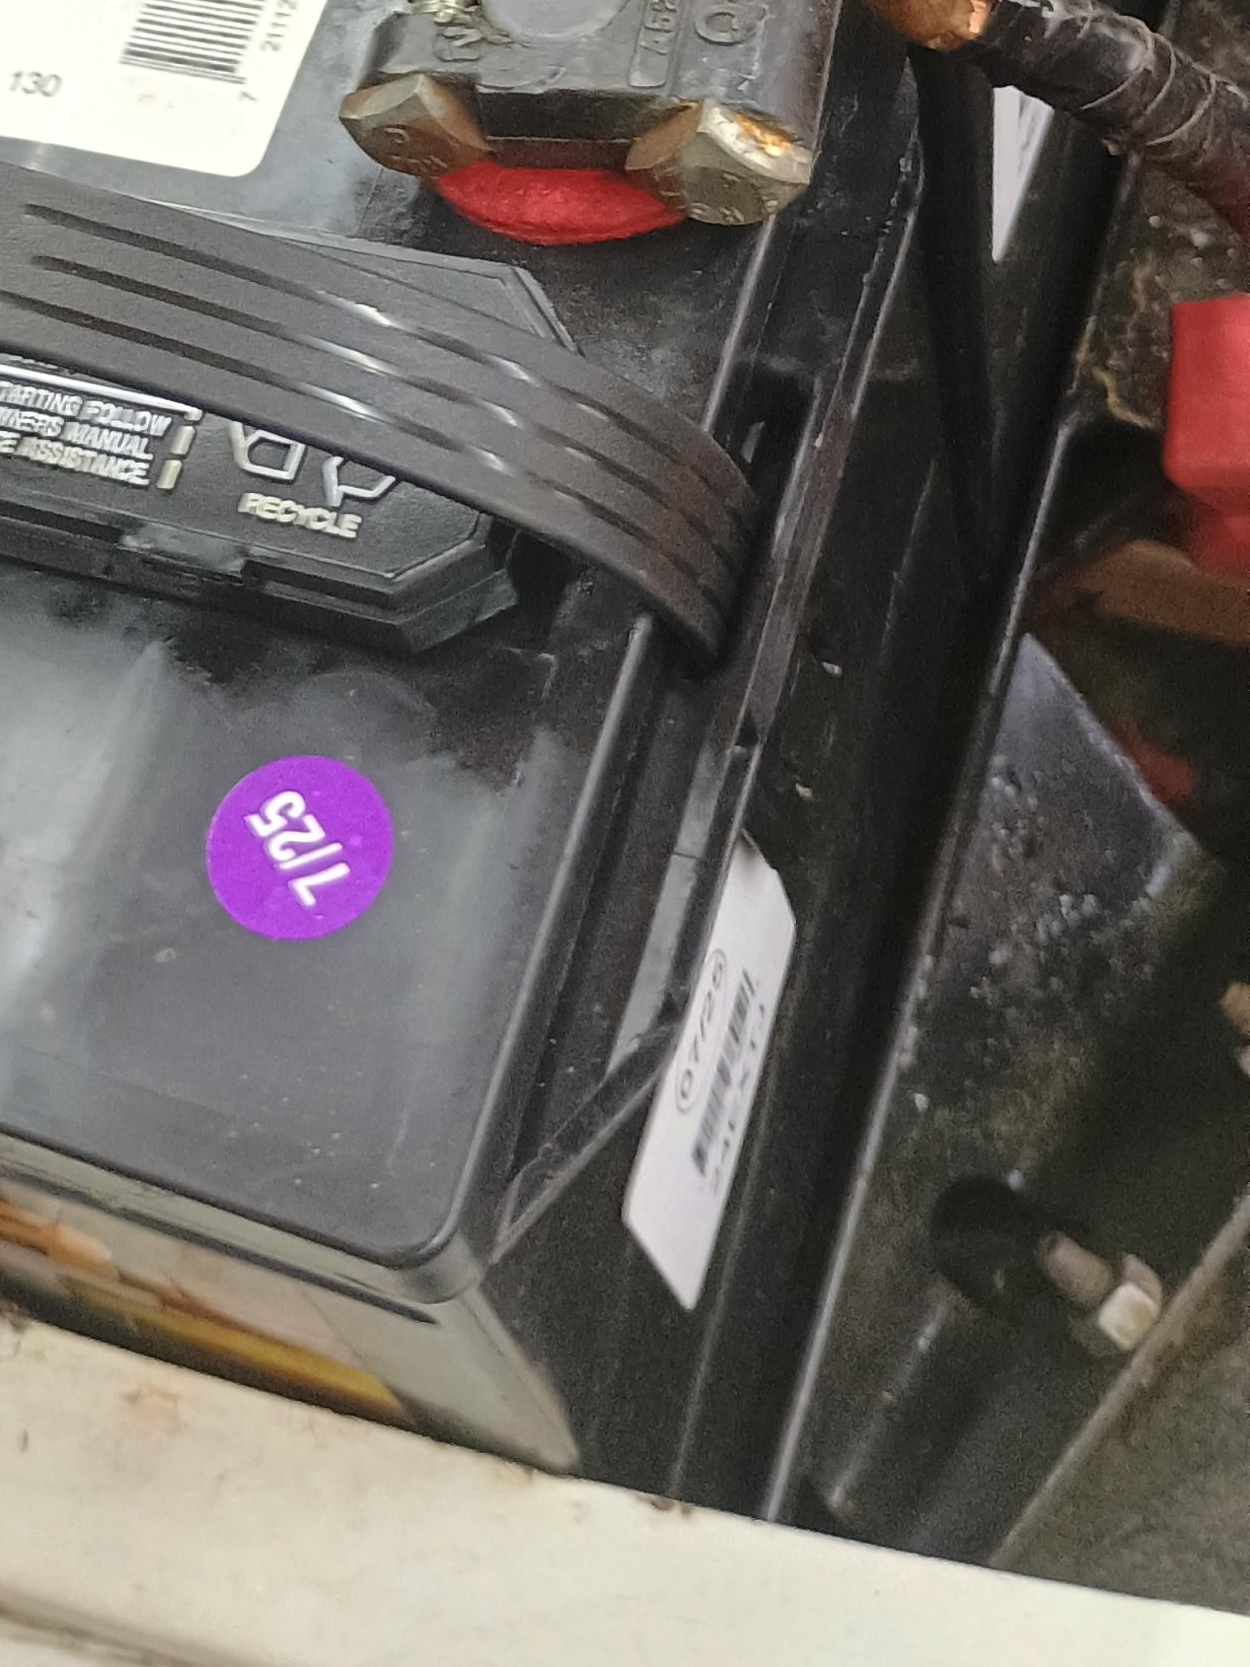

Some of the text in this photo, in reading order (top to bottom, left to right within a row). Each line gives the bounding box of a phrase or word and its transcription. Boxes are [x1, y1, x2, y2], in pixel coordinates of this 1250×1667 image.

[8, 70, 64, 98] 130
[79, 399, 173, 437] FOLLOW
[237, 492, 363, 540] RECYCLE
[244, 790, 351, 907] 7/25
